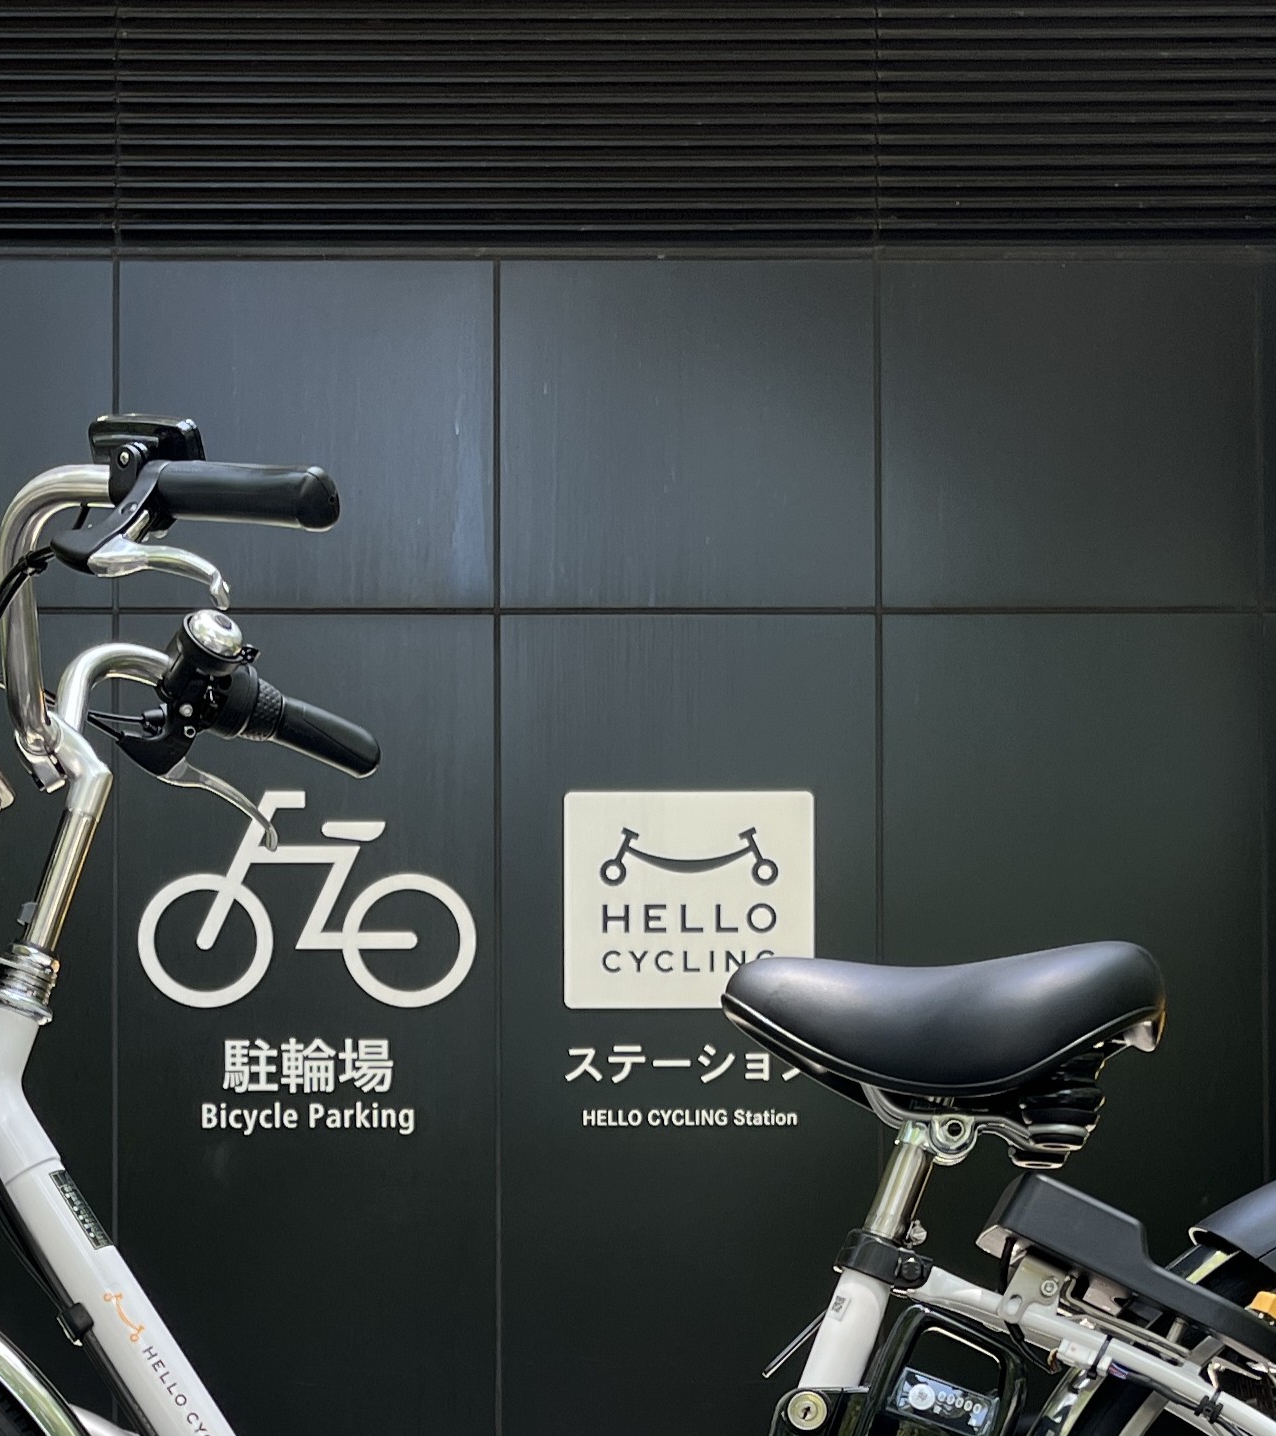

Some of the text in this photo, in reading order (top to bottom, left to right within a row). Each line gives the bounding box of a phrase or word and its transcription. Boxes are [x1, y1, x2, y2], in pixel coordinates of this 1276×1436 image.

[601, 902, 778, 934] HELLO
[222, 1037, 394, 1094] 駐輪場
[564, 1043, 801, 1084] ステーショ
[201, 1101, 416, 1136] Bicycle Parking
[581, 1109, 799, 1127] HELLO CYCLING Station
[142, 1345, 188, 1407] HELLO
